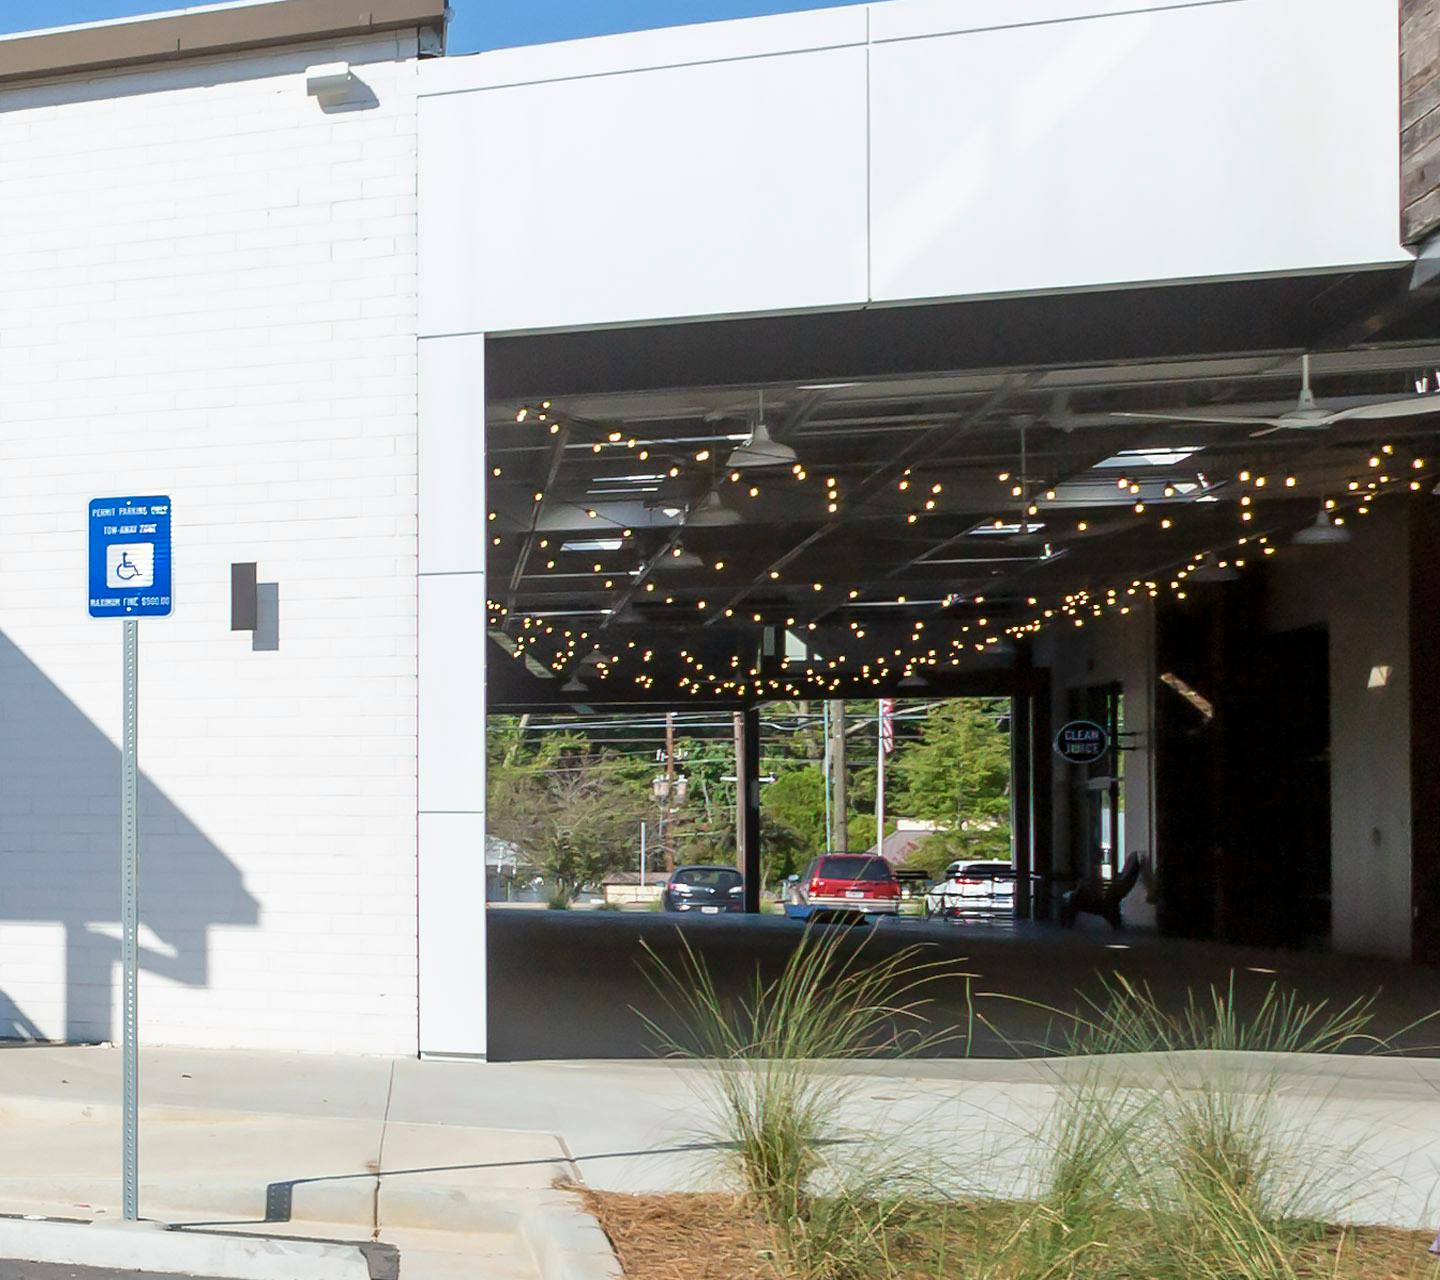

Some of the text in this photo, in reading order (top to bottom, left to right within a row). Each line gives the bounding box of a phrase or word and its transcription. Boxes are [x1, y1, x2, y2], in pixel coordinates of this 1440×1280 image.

[92, 508, 115, 517] PERMIT
[123, 597, 139, 606] FINE
[1065, 730, 1099, 740] CLEAN
